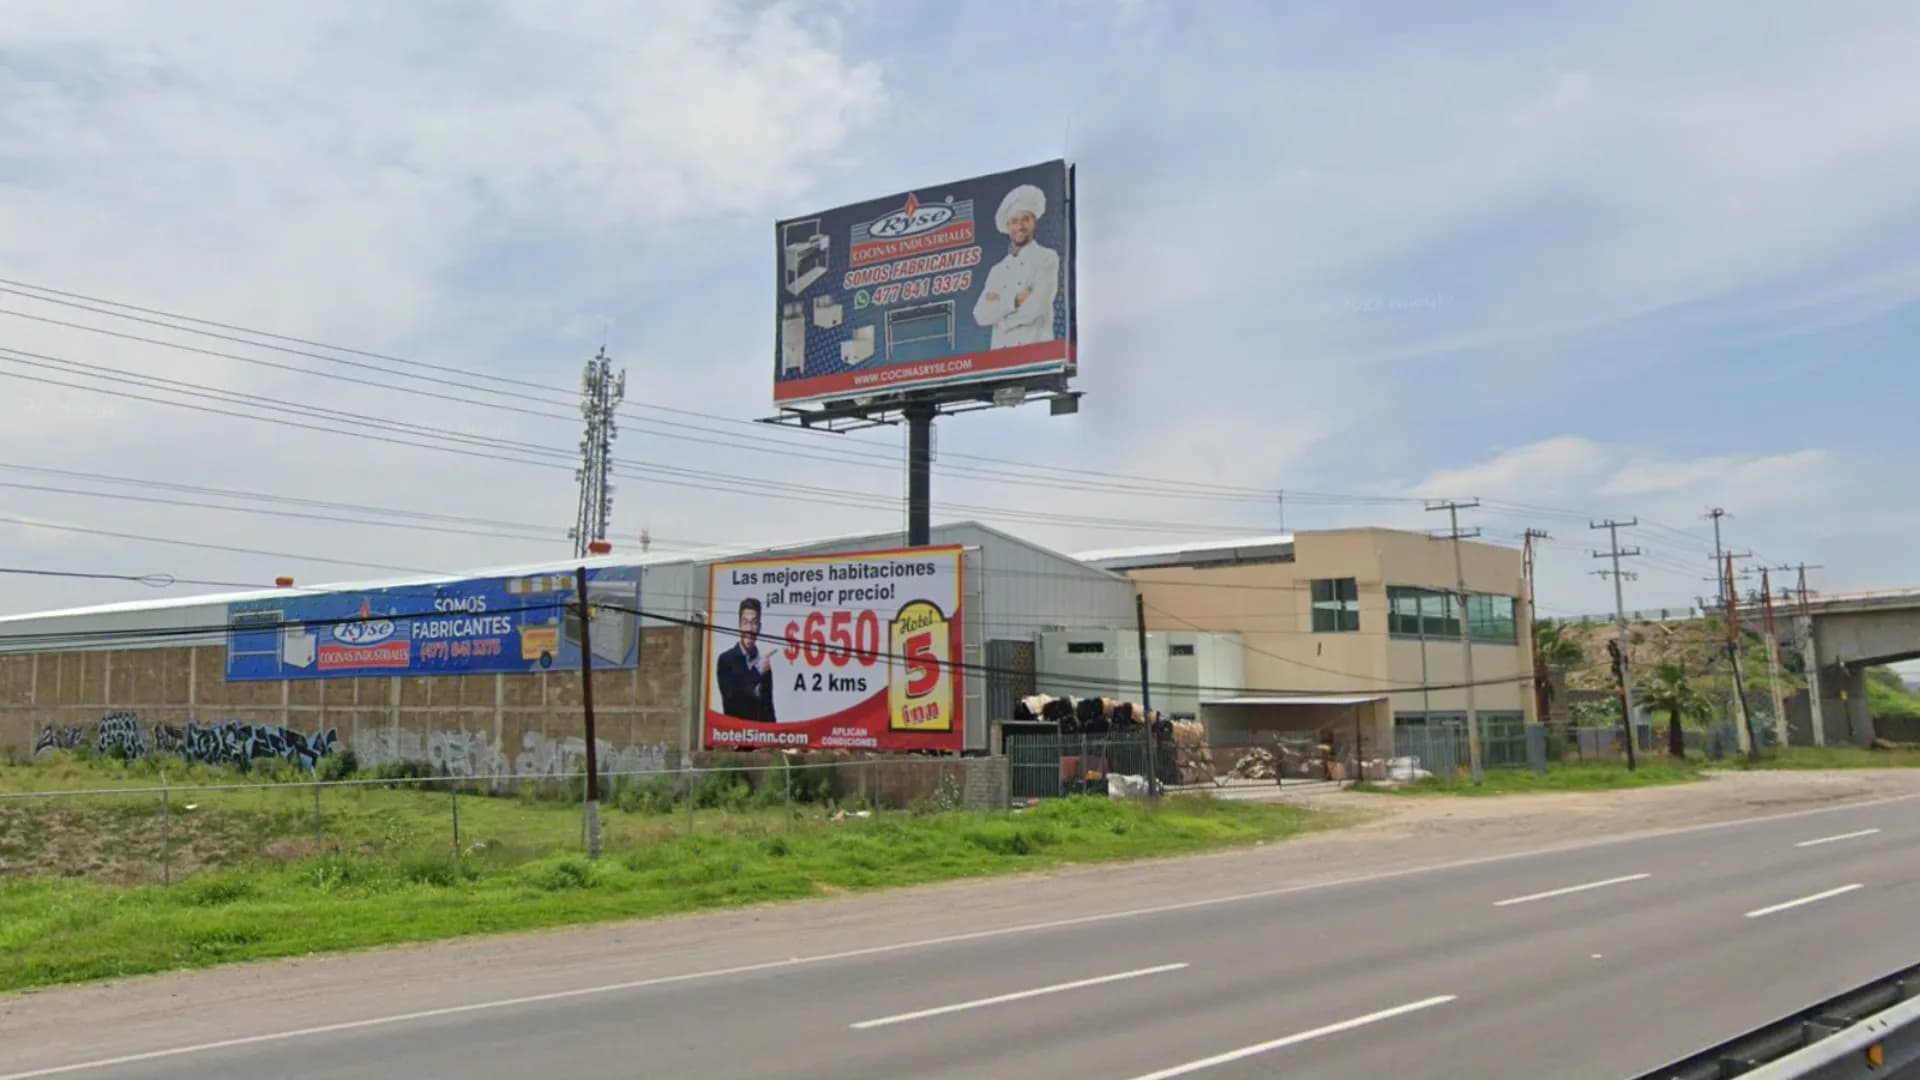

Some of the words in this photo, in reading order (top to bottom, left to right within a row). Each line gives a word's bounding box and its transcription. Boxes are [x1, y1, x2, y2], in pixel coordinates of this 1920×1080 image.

[880, 211, 946, 235] Ryse
[852, 244, 897, 260] COCINAS
[899, 229, 973, 251] INDUSTRIALES
[844, 264, 891, 289] SOMOS
[891, 247, 982, 280] FABRICANTES
[873, 283, 901, 304] 477
[902, 278, 930, 300] 841
[932, 270, 972, 295] 3375
[854, 359, 972, 384] WWW.COCINASRYSE.COM
[732, 569, 758, 585] Las
[762, 567, 824, 587] mejores
[828, 560, 936, 582] habitaciones
[434, 596, 487, 612] SOMOS
[766, 588, 785, 608] ¡al
[789, 587, 835, 605] mejor
[838, 583, 896, 605] precio!
[341, 622, 390, 641] Ryse
[412, 616, 512, 640] FABRICANTES
[899, 609, 934, 635] Hotel
[783, 608, 880, 669] $650
[904, 631, 941, 699] 5
[793, 672, 805, 692] A
[811, 672, 823, 692] 2
[828, 672, 867, 692] kms
[903, 701, 940, 725] inn
[712, 727, 809, 745] hotel5inn.com
[821, 736, 878, 748] CONDICIONES
[831, 727, 868, 737] APLICAN
